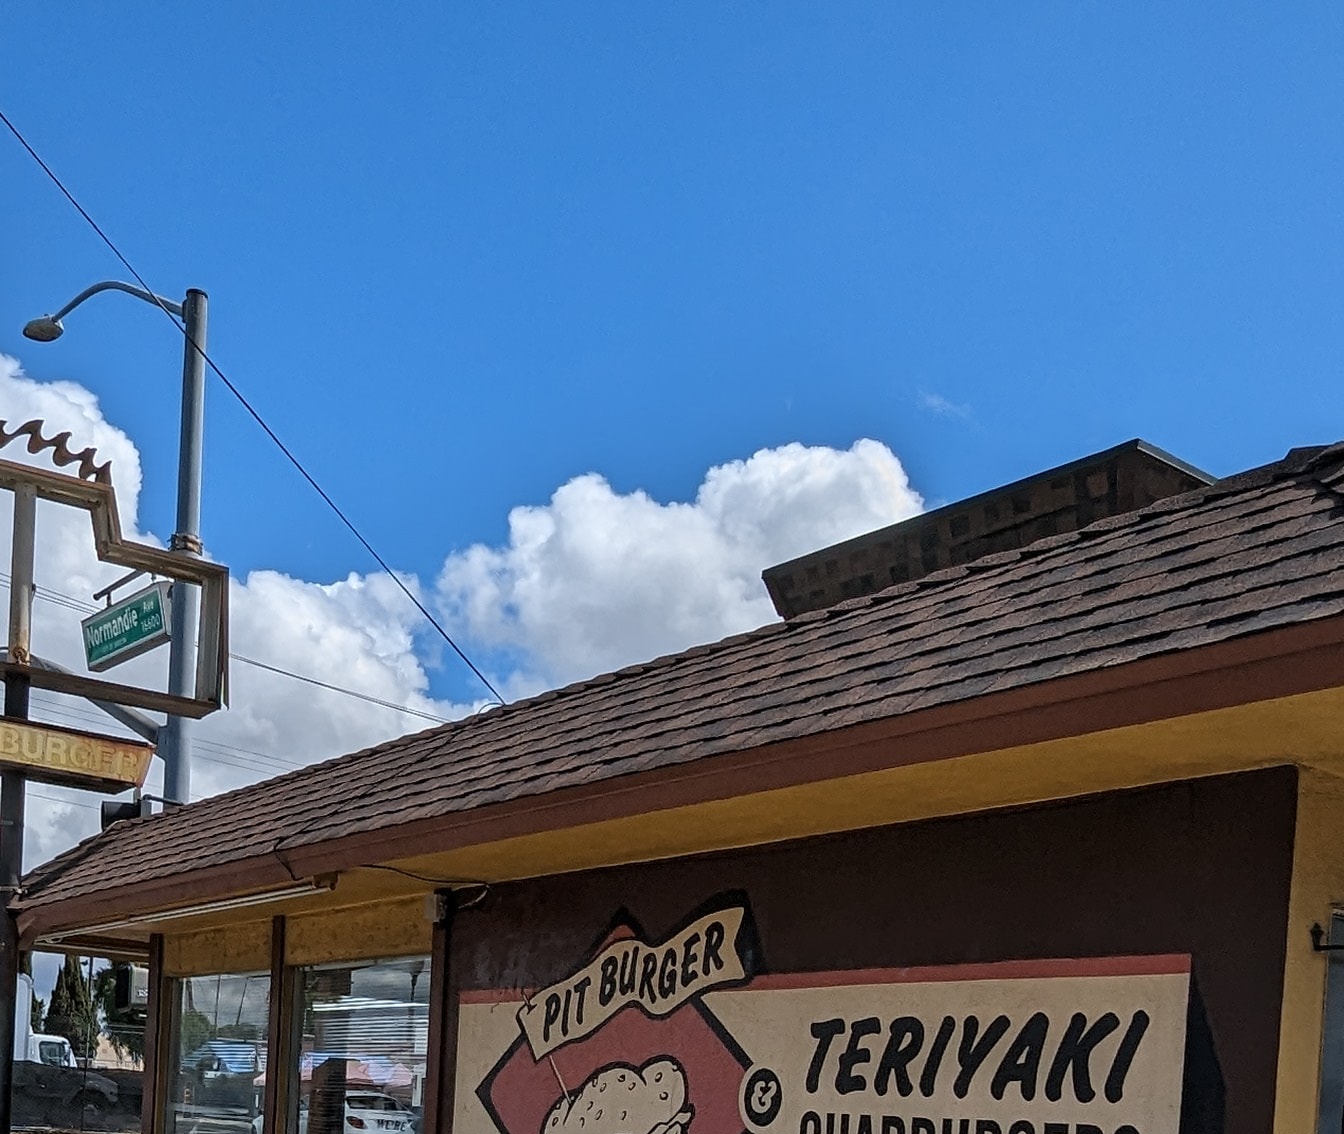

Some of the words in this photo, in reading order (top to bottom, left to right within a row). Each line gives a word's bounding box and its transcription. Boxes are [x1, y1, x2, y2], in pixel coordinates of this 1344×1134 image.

[86, 606, 138, 648] Normandie
[543, 977, 591, 1043] PIT
[599, 921, 725, 1007] BURGER
[805, 1010, 1150, 1104] TERIYAKI
